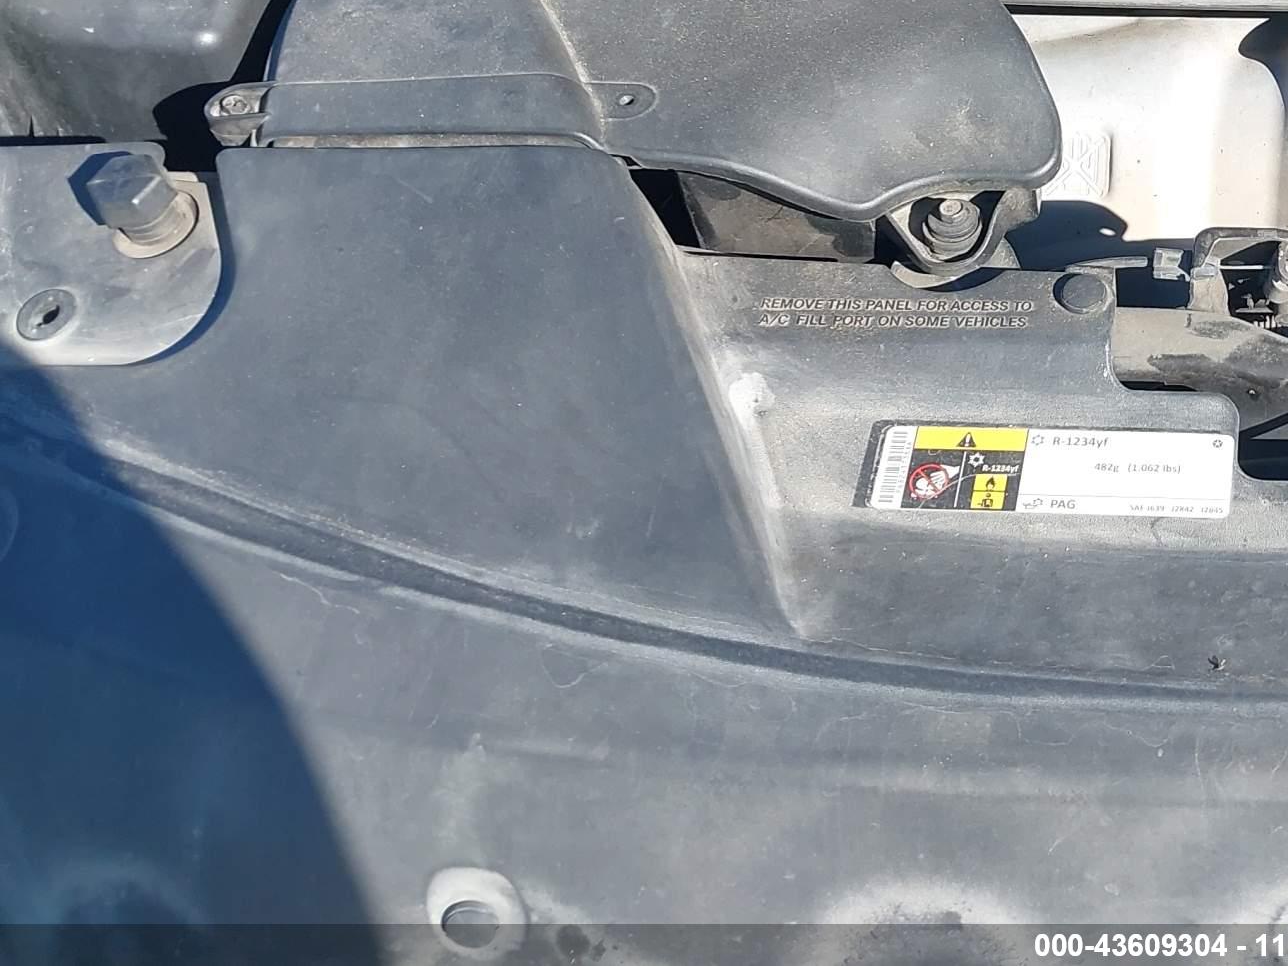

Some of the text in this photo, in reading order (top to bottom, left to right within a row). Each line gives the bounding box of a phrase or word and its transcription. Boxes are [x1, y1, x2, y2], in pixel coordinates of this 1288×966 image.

[760, 297, 1032, 312] REMOVE THIS PANEL FOR ACCESS TO
[759, 314, 1027, 328] A/C FILL PORT ON SOME VEHICLES
[1052, 436, 1109, 450] R-1234yf
[982, 464, 1020, 474] R-1234yf
[1094, 462, 1182, 475] 482g (1.062 lbs)
[1050, 499, 1076, 510] PAG
